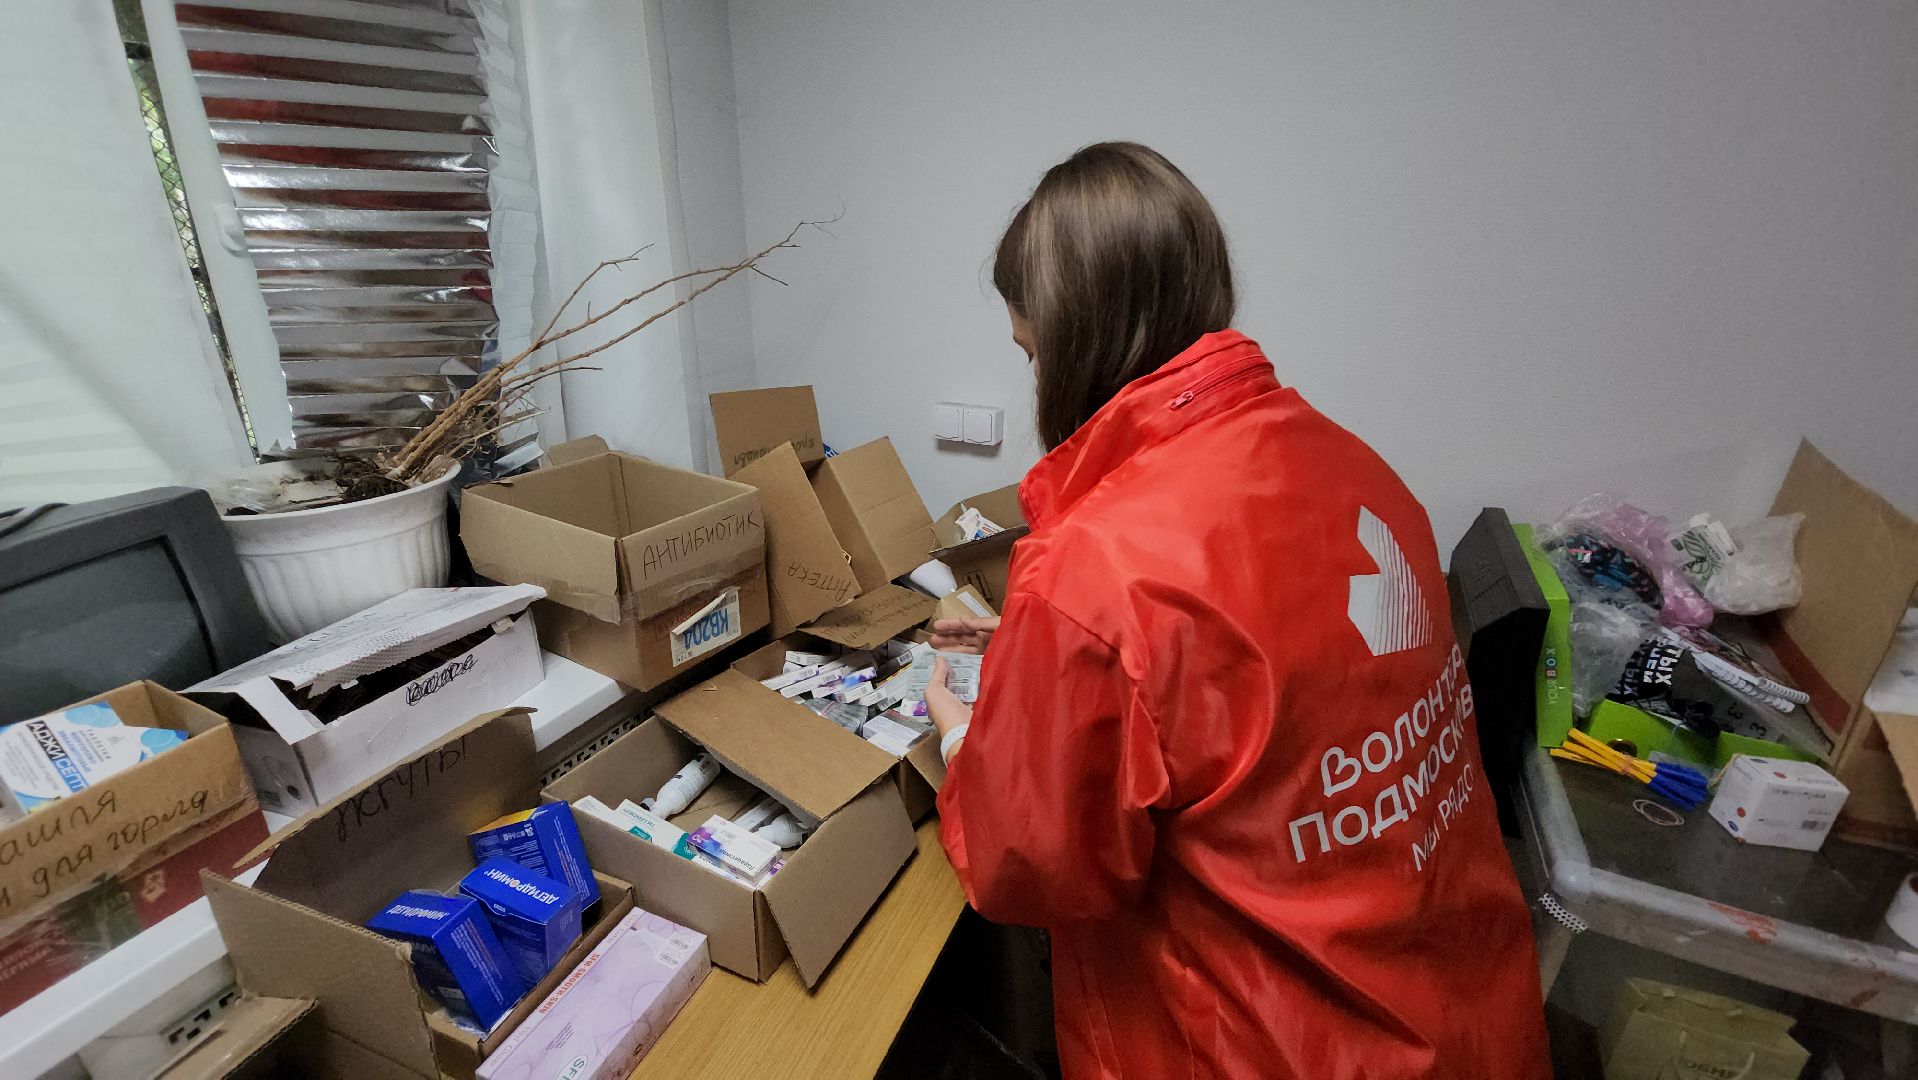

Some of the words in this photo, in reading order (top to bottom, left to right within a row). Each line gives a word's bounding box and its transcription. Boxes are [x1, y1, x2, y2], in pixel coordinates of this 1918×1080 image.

[643, 509, 761, 580] АНТИБИОТИК
[787, 561, 851, 602] АПТЕКА
[28, 719, 89, 793] АДЖИСЕПТ
[1411, 818, 1441, 871] МЫ
